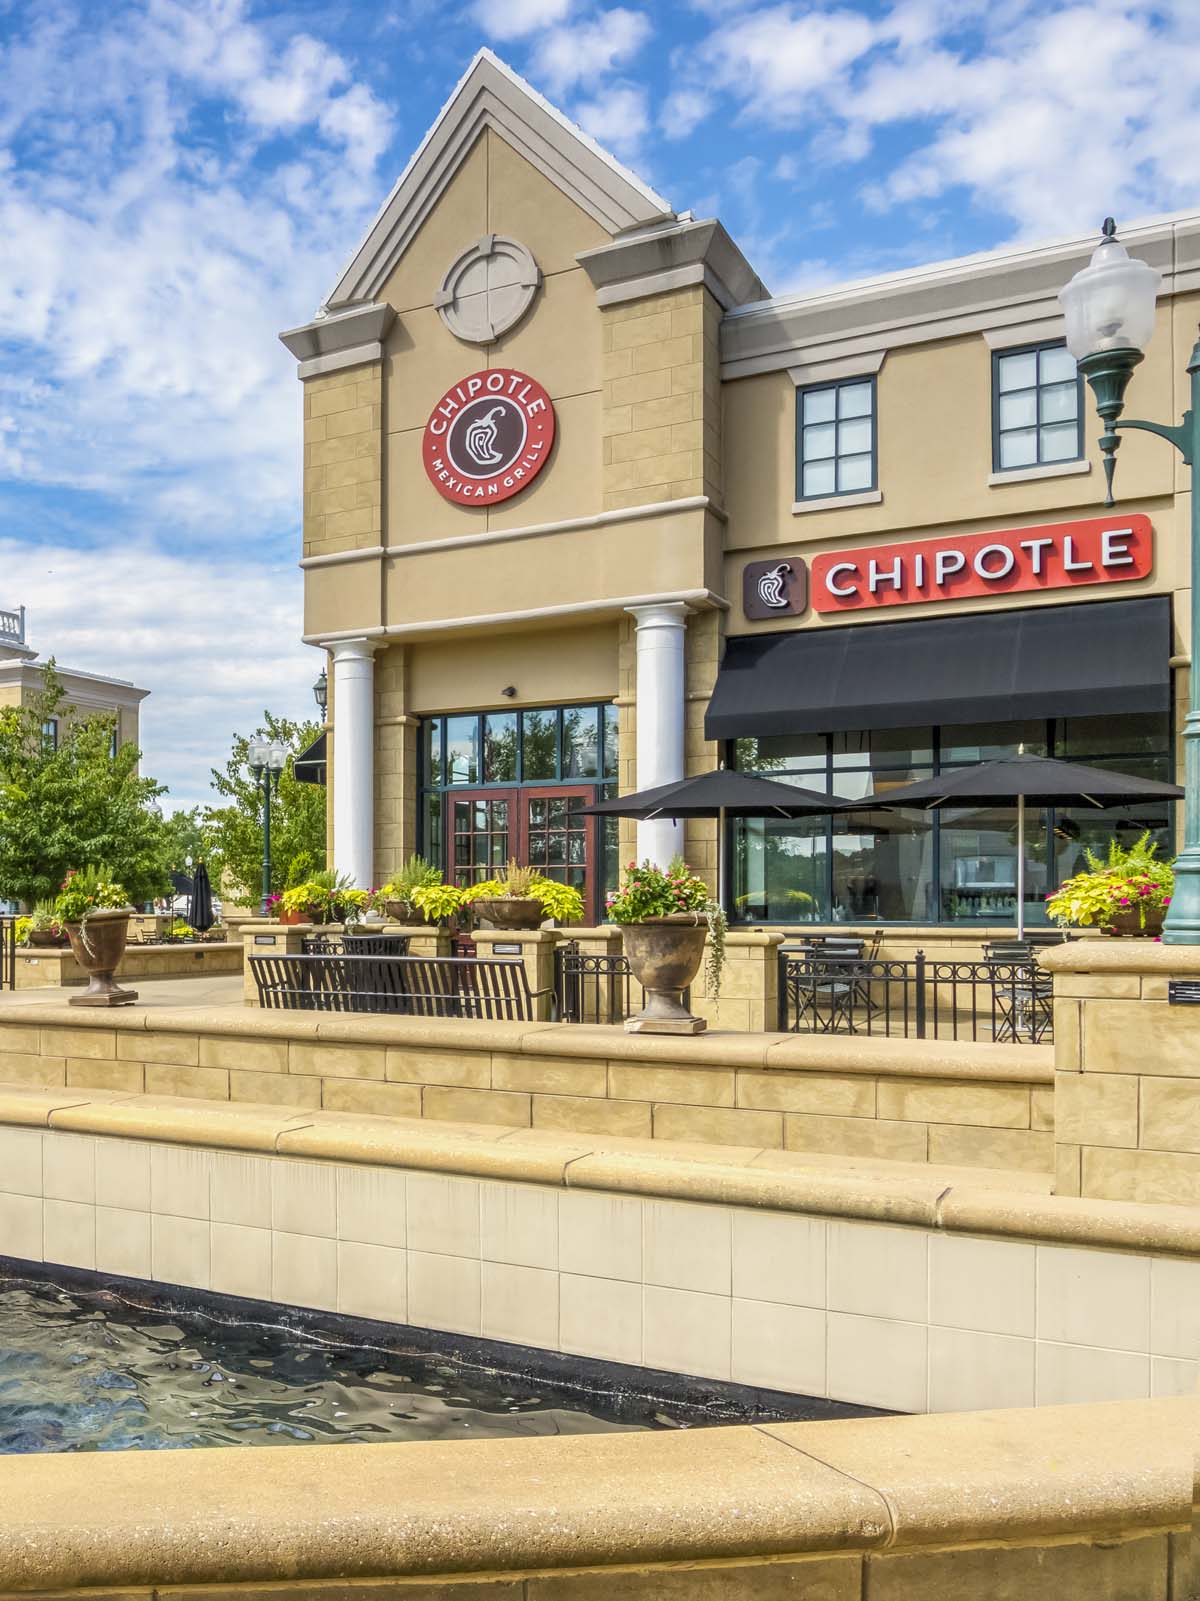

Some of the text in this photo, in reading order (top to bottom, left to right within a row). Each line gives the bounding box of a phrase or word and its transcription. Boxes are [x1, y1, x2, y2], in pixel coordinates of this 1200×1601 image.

[430, 373, 546, 435] CHIPOTLE
[432, 441, 543, 496] MEXICAN GRILL
[825, 528, 1133, 596] CHIPOTLE
